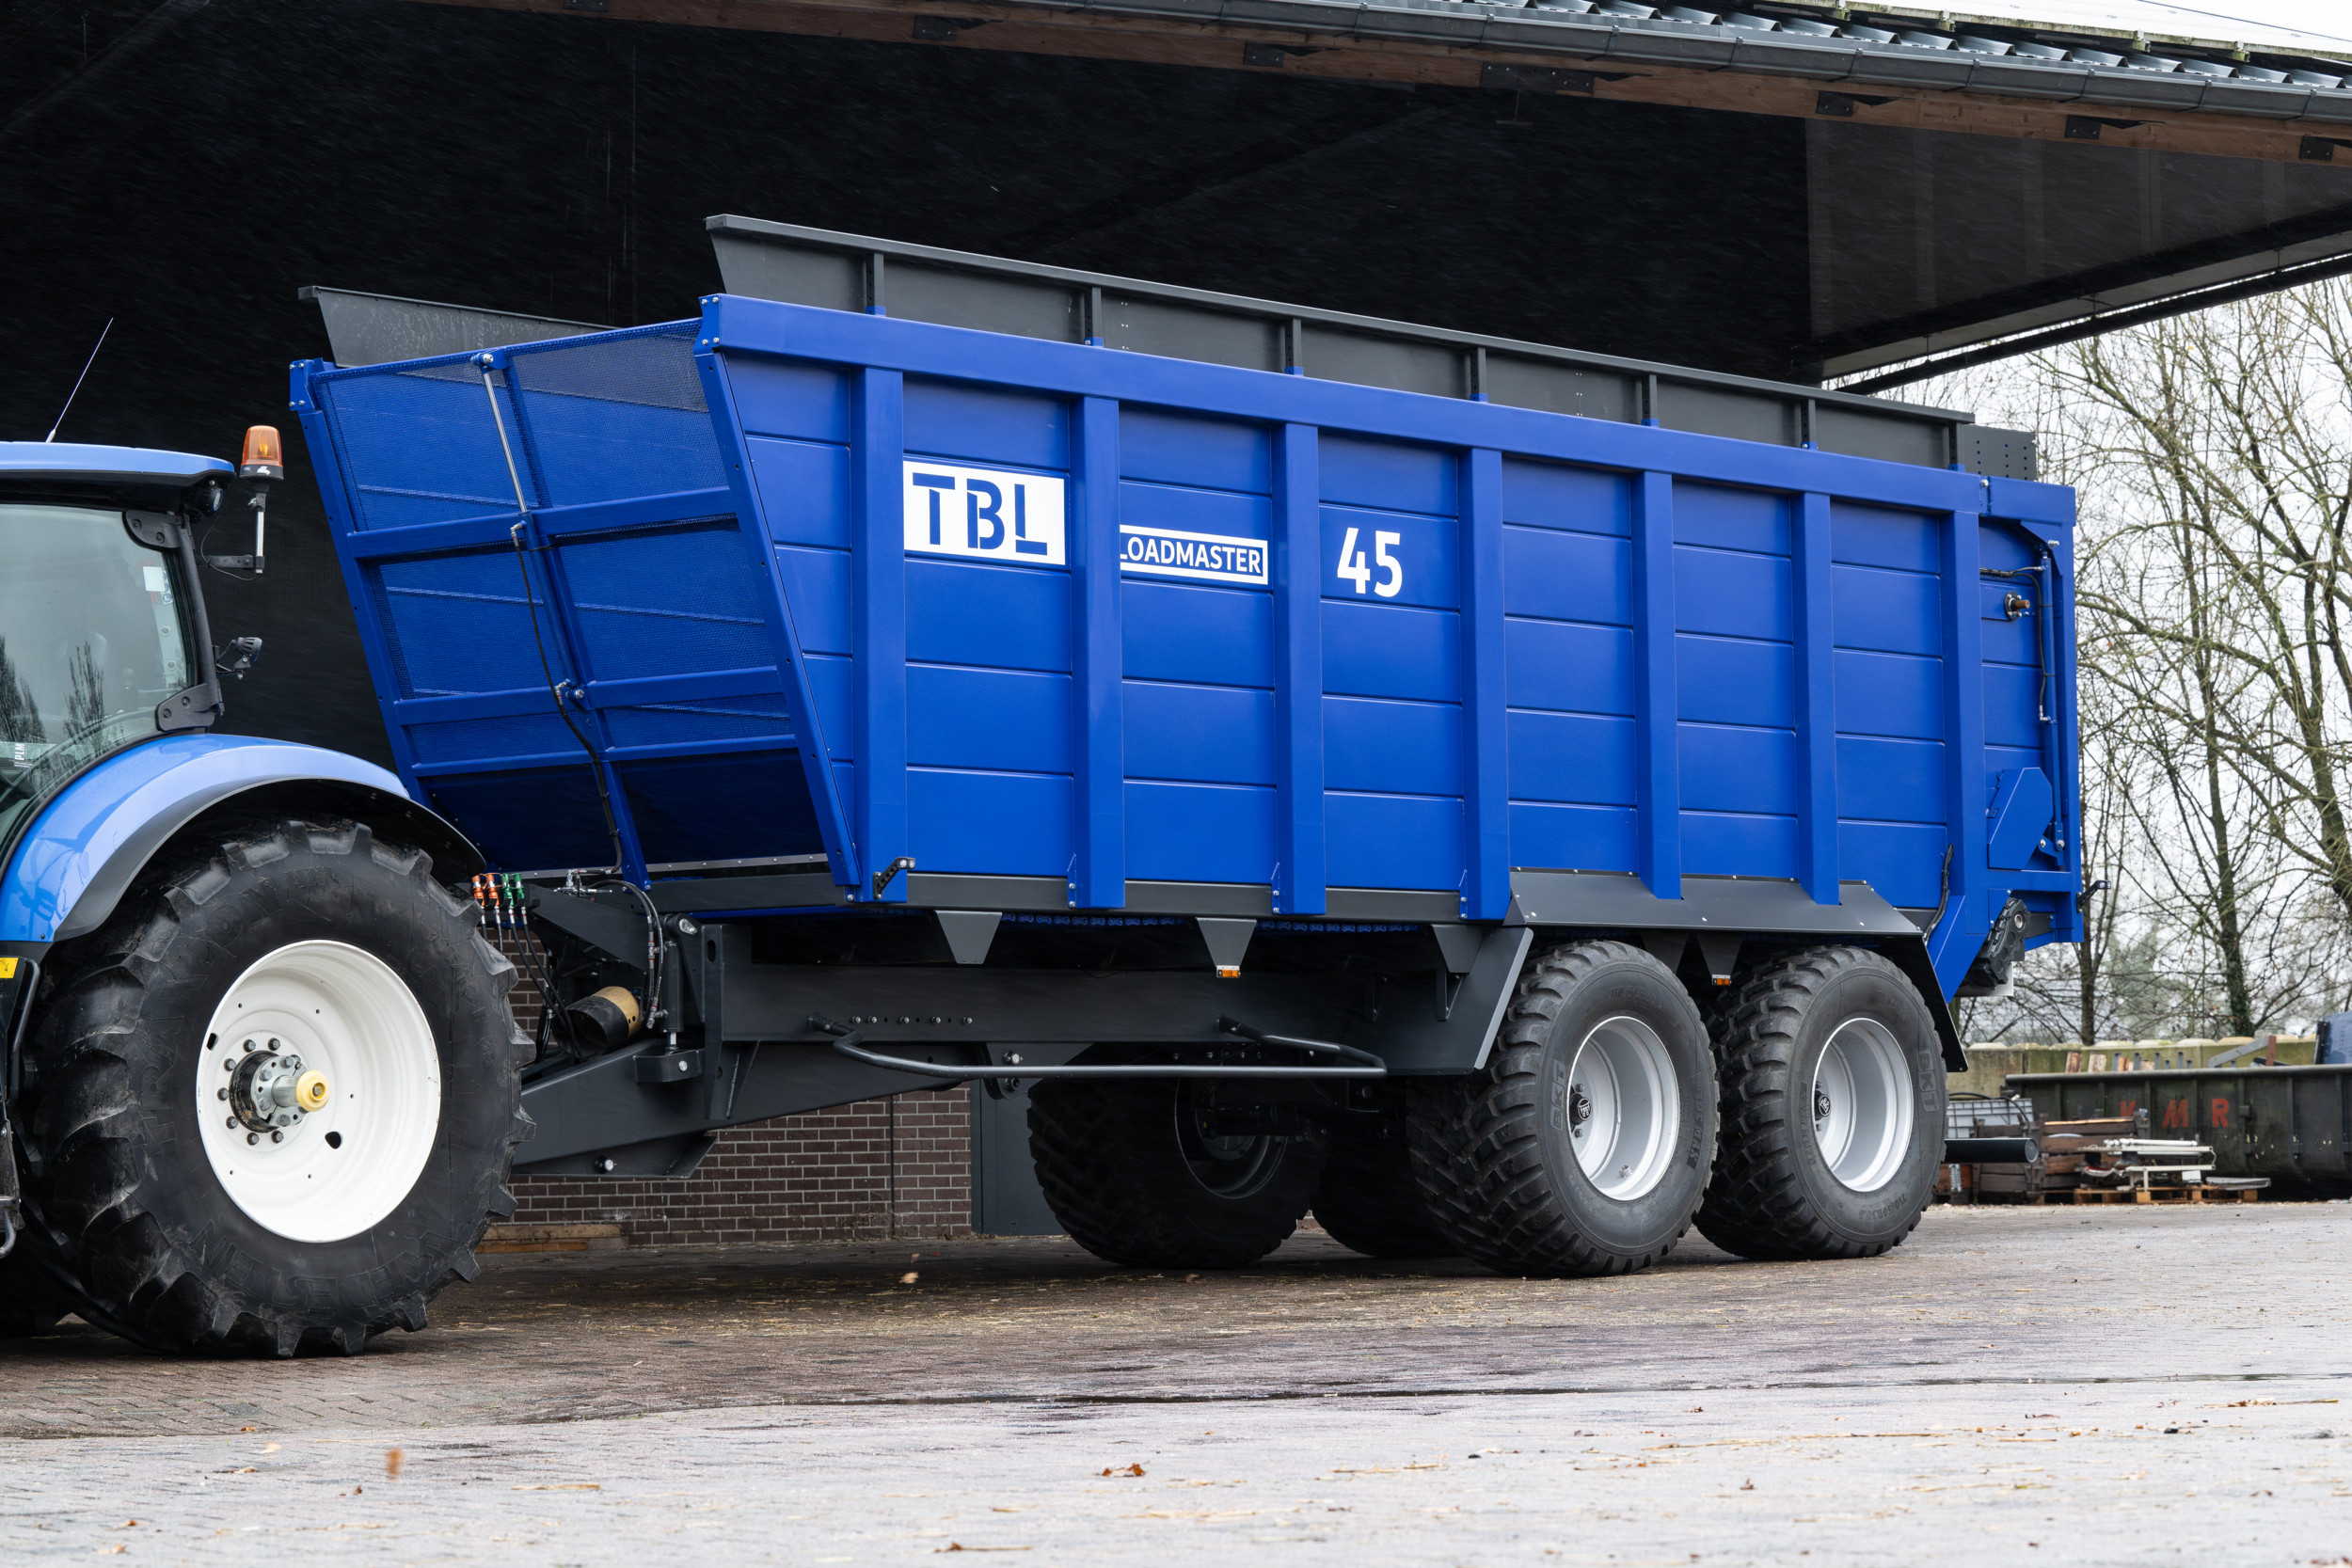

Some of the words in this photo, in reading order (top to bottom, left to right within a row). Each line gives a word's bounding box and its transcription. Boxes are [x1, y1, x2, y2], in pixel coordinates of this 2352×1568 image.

[913, 472, 1048, 556] TBL
[1337, 527, 1403, 597] 45
[1918, 1051, 1938, 1112] BKT
